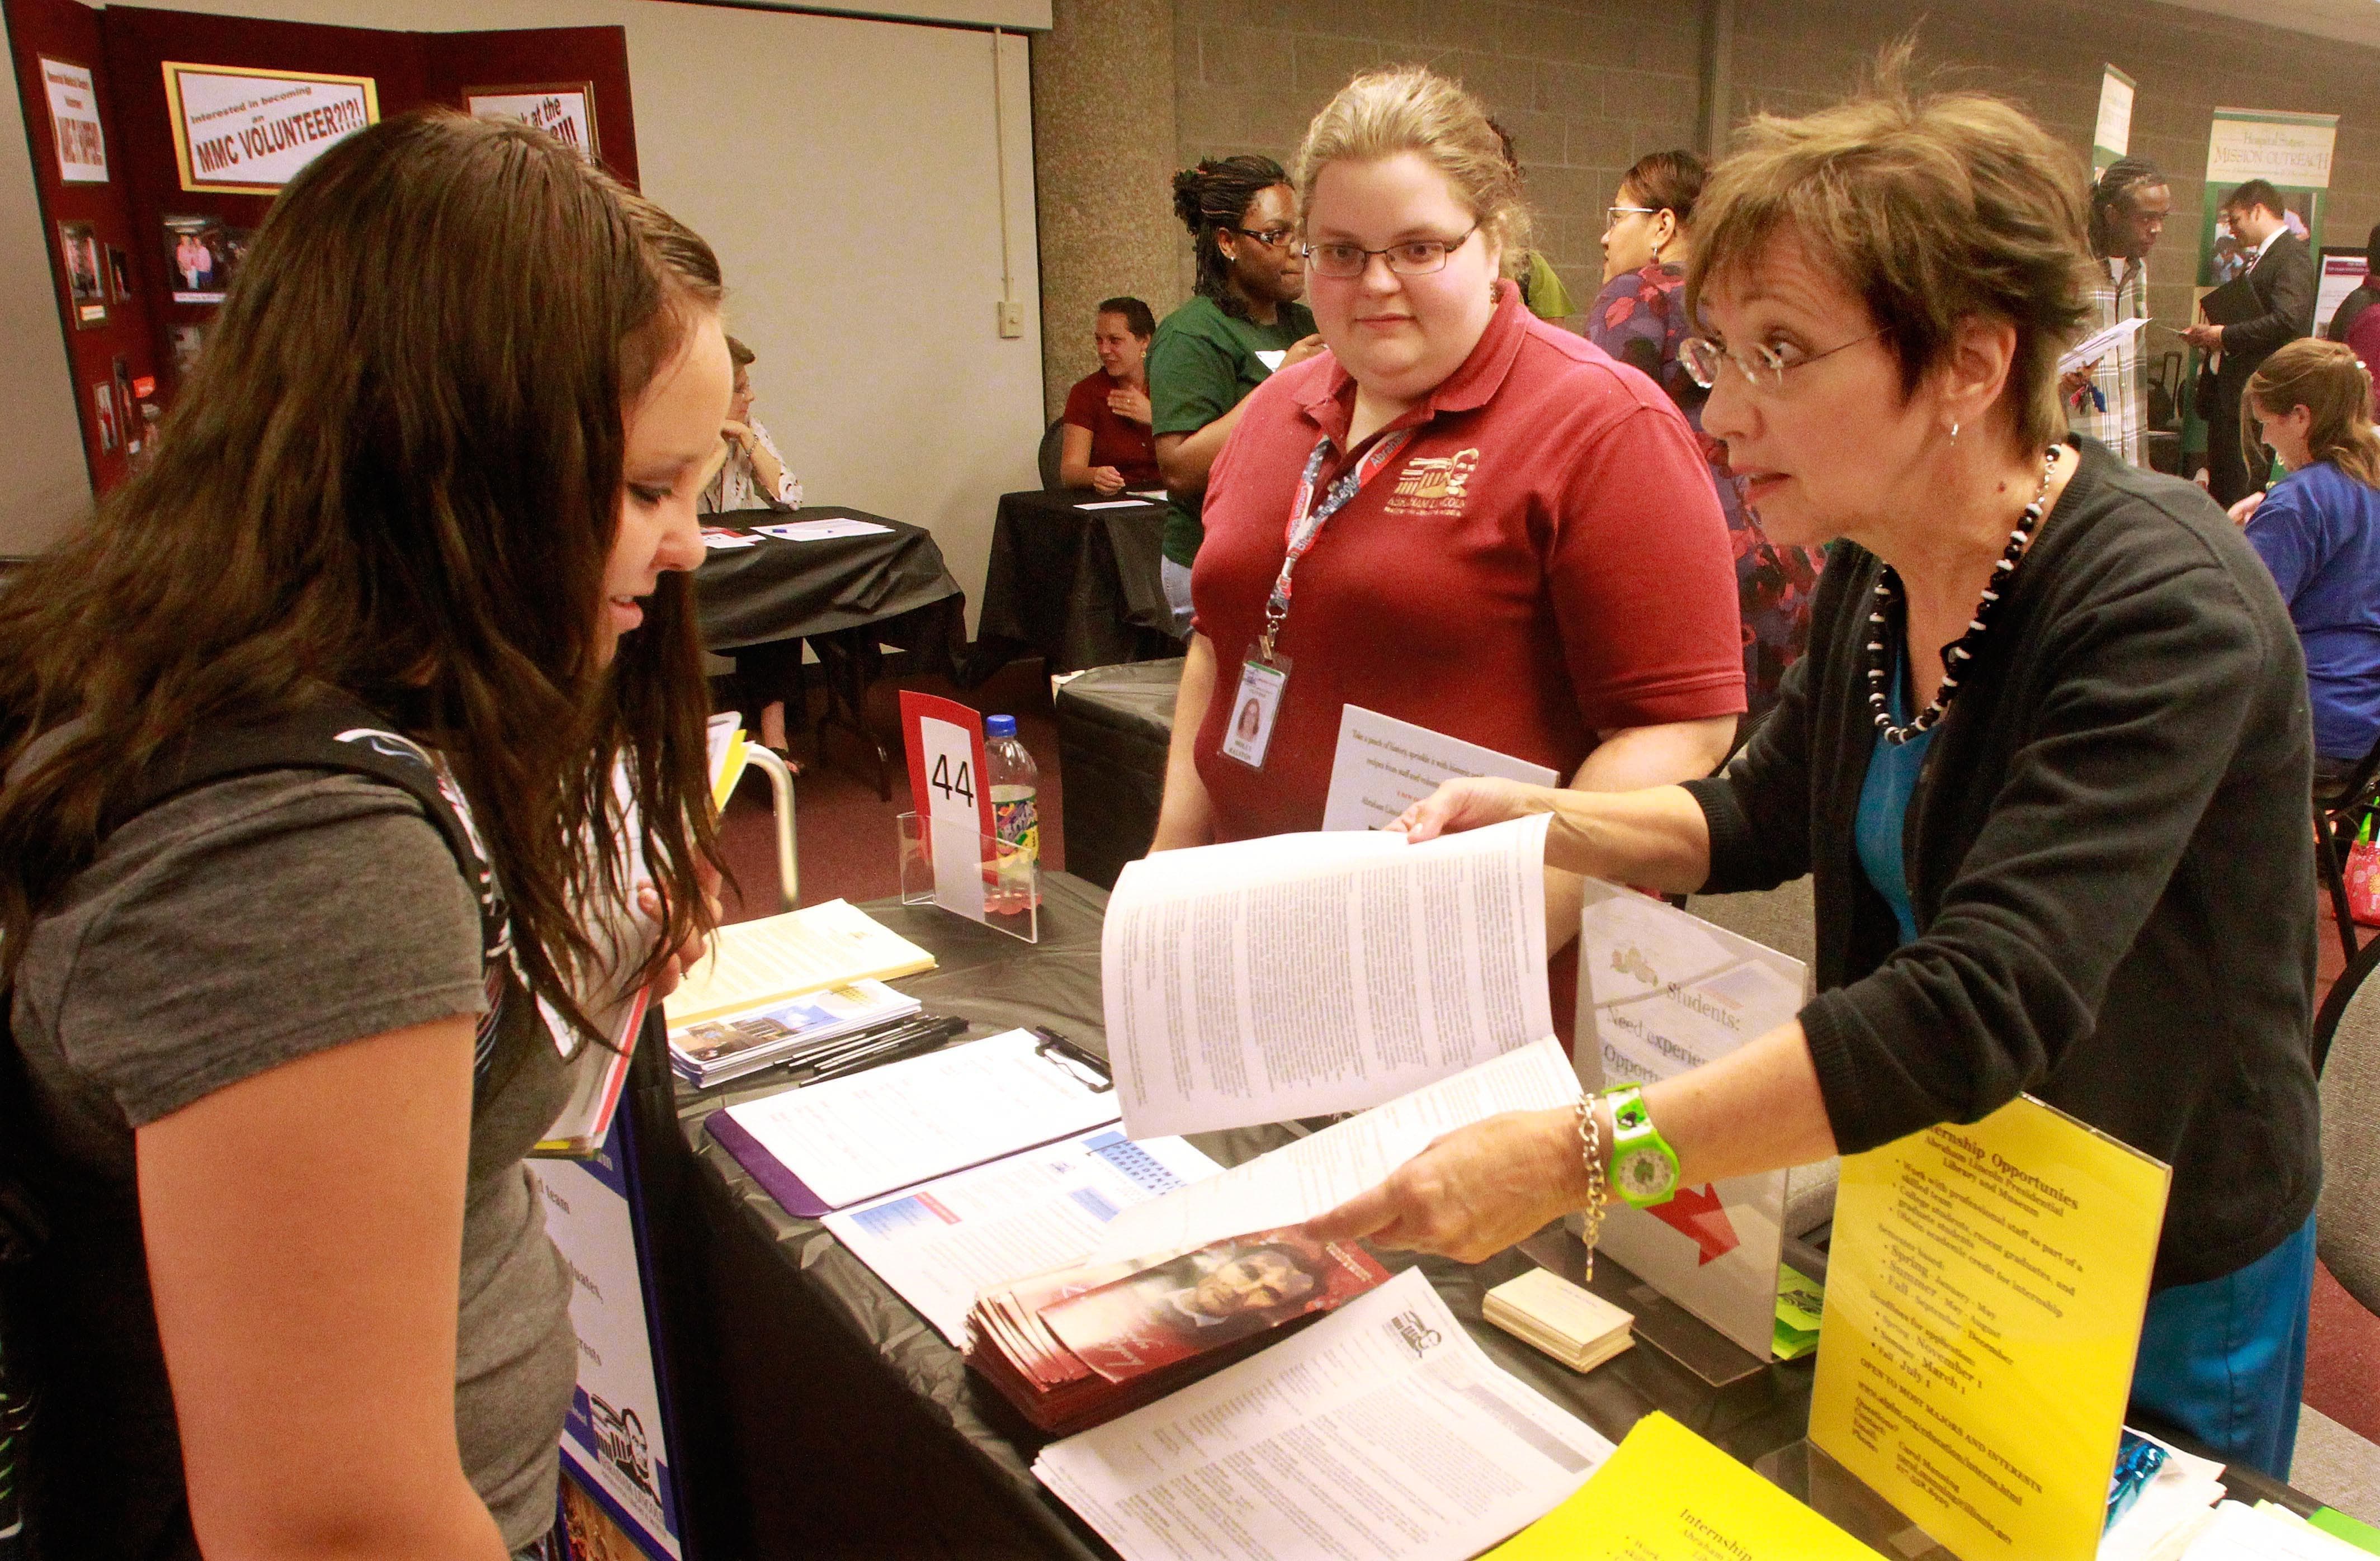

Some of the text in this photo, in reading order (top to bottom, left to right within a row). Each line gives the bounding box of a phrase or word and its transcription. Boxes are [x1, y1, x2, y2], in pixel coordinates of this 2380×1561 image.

[190, 86, 312, 124] Interested in becoming
[252, 115, 264, 125] an
[532, 103, 544, 126] at
[544, 96, 562, 122] the
[196, 98, 363, 173] MMC VOLUNTEER?!?!
[2214, 146, 2329, 169] MISSION OUTREACH
[932, 753, 974, 808] 44
[1607, 1005, 1643, 1038] Need
[1666, 981, 1740, 1031] Students:
[1931, 1125, 1985, 1160] ernship
[1113, 1144, 1174, 1190] PRESIDENTI
[1978, 1179, 1997, 1193] and
[1899, 1360, 1923, 1384] July
[1916, 1336, 1975, 1382] November
[1921, 1357, 1957, 1389] March
[1860, 1357, 2042, 1493] OPEN TO MOST MAJORS AND INTERESTS
[1679, 1508, 1751, 1560] Internship
